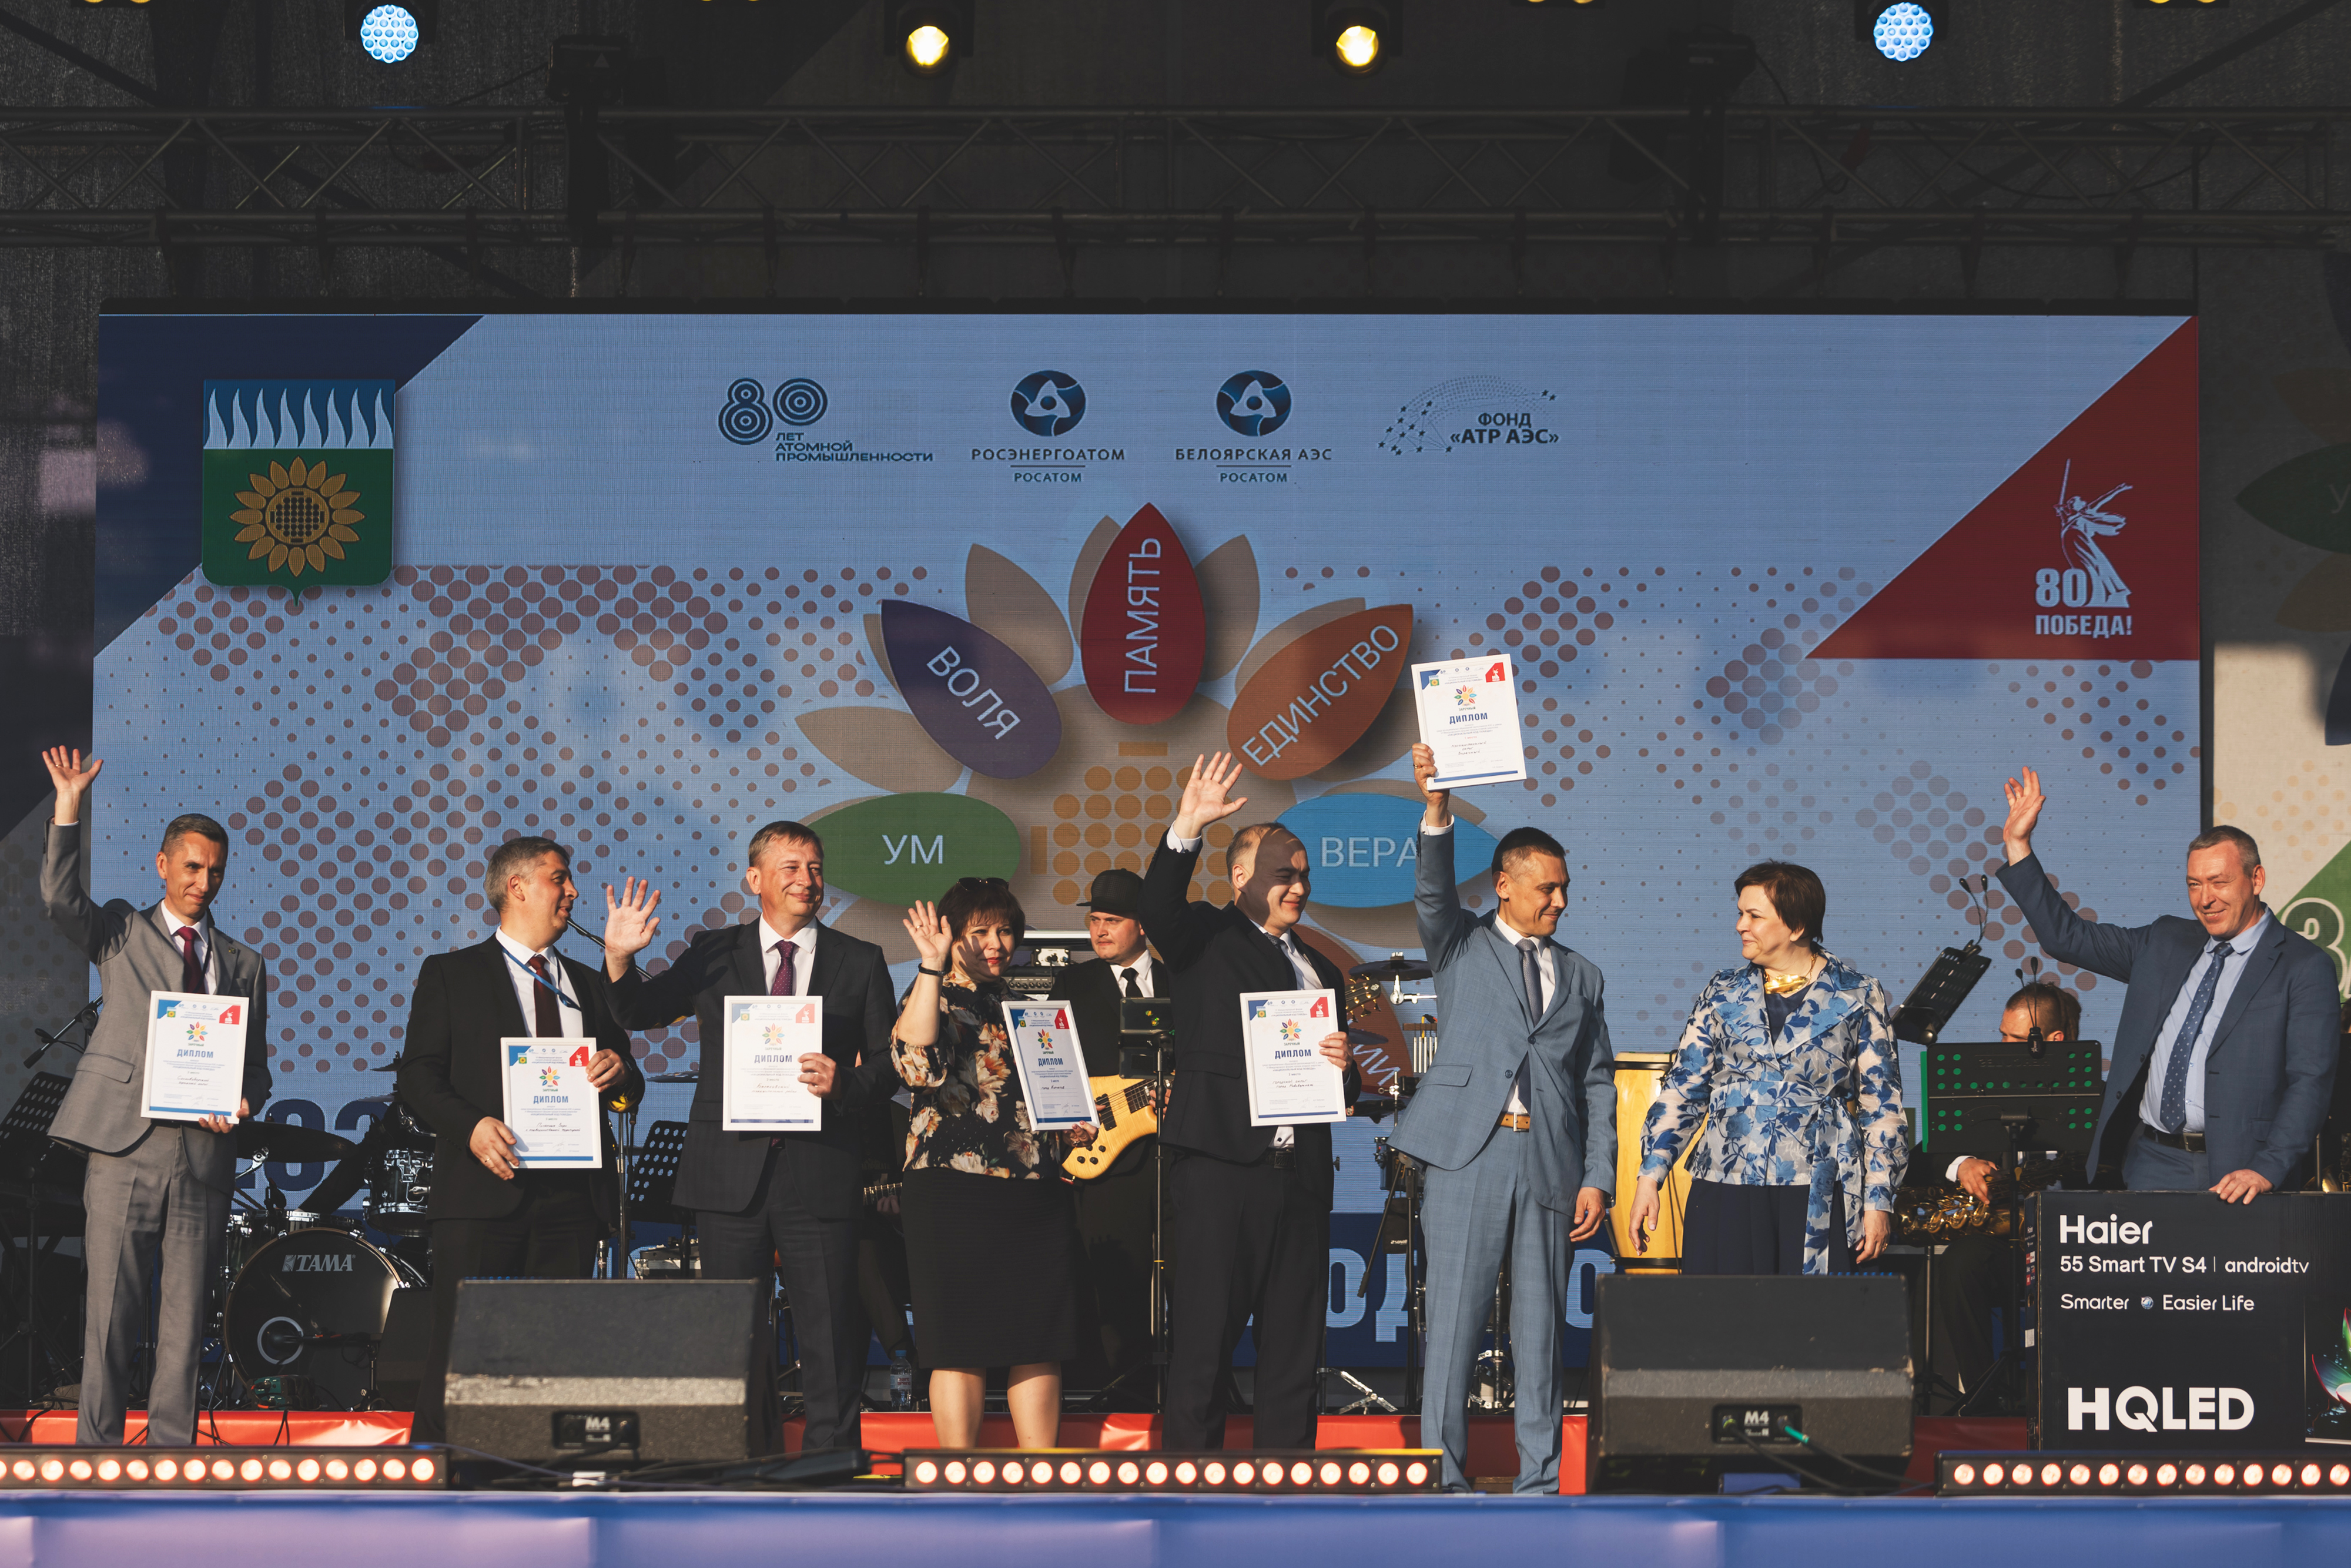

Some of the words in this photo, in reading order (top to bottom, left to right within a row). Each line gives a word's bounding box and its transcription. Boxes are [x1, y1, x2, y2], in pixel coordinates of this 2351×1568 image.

[718, 377, 828, 445] 80
[1478, 413, 1531, 428] ФОНД
[775, 433, 804, 441] ЛЕТ
[1450, 429, 1501, 444] «АТР
[1509, 429, 1559, 444] АЭС»
[775, 441, 853, 452] АТОМНОЙ
[775, 453, 933, 462] ПРОМЫШЛЕННОСТИ
[972, 448, 1126, 461] РОСЭНЕРГОАТОМ
[1176, 448, 1292, 461] БЕЛОЯРСКАЯ
[1298, 448, 1332, 461] АЭС
[1014, 473, 1082, 483] РОСАТОМ
[1220, 473, 1288, 483] РОСАТОМ
[2035, 568, 2087, 608] 80
[1124, 537, 1161, 693] ПАМЯТЬ
[2035, 615, 2132, 638] ПОБЕДА!
[926, 646, 1021, 740] ВОЛЯ
[1241, 625, 1399, 766] ЕДИНСТВО
[1449, 713, 1488, 724] ДИПЛОМ
[882, 835, 944, 865] УМ
[1321, 836, 1418, 867] ВЕРА
[177, 1049, 213, 1058] ДИПЛОМ
[754, 1055, 792, 1063] ДИПЛОМ
[1275, 1049, 1311, 1059] ДИПЛОМ
[1038, 1058, 1063, 1067] ДИПЛОМ
[533, 1095, 568, 1104] ДИПЛОМ
[2060, 1214, 2153, 1244] Haier
[297, 1254, 353, 1272] TAMA
[2061, 1256, 2083, 1272] 55
[2089, 1256, 2145, 1272] Smart
[2149, 1257, 2176, 1272] TV
[2182, 1257, 2206, 1273] S4
[2225, 1257, 2309, 1274] androidtv
[2061, 1294, 2129, 1309] Smarter
[2163, 1295, 2217, 1311] Easier
[2222, 1295, 2255, 1311] Life
[2068, 1386, 2255, 1432] HQLED
[585, 1416, 611, 1430] M4
[1744, 1410, 1769, 1424] M4
